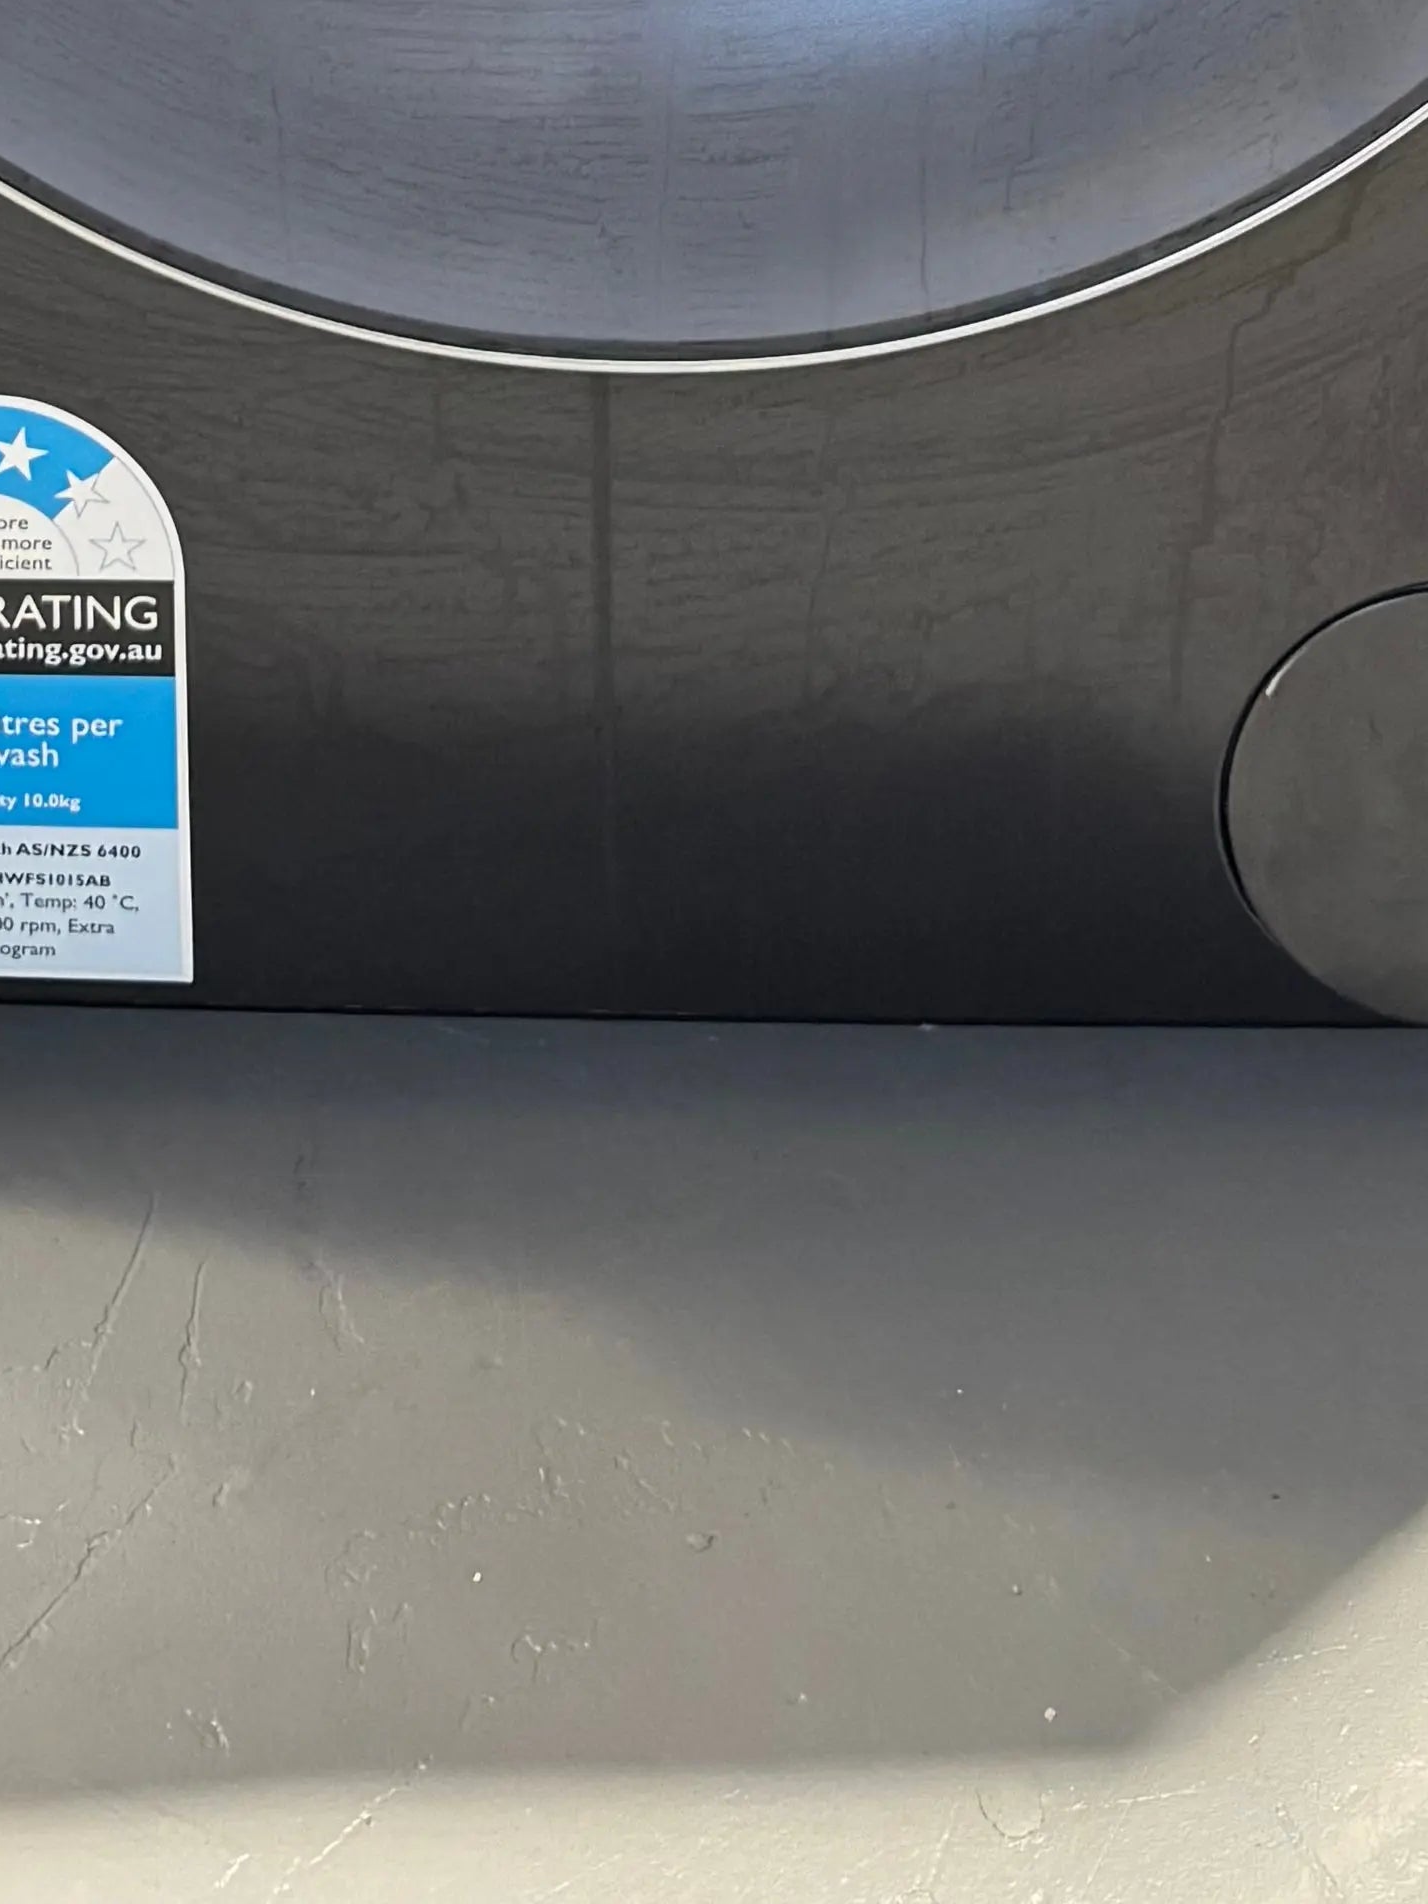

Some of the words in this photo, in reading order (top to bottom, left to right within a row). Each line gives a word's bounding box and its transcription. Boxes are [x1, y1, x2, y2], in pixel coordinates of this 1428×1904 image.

[2, 539, 52, 550] more
[71, 717, 123, 744] per
[24, 793, 80, 812] 10.0kg
[16, 843, 91, 857] AS/NZS
[97, 845, 141, 859] 6400
[22, 893, 76, 912] Temp:
[83, 896, 106, 910] 40
[21, 919, 61, 935] rpm,
[68, 919, 115, 934] Extra
